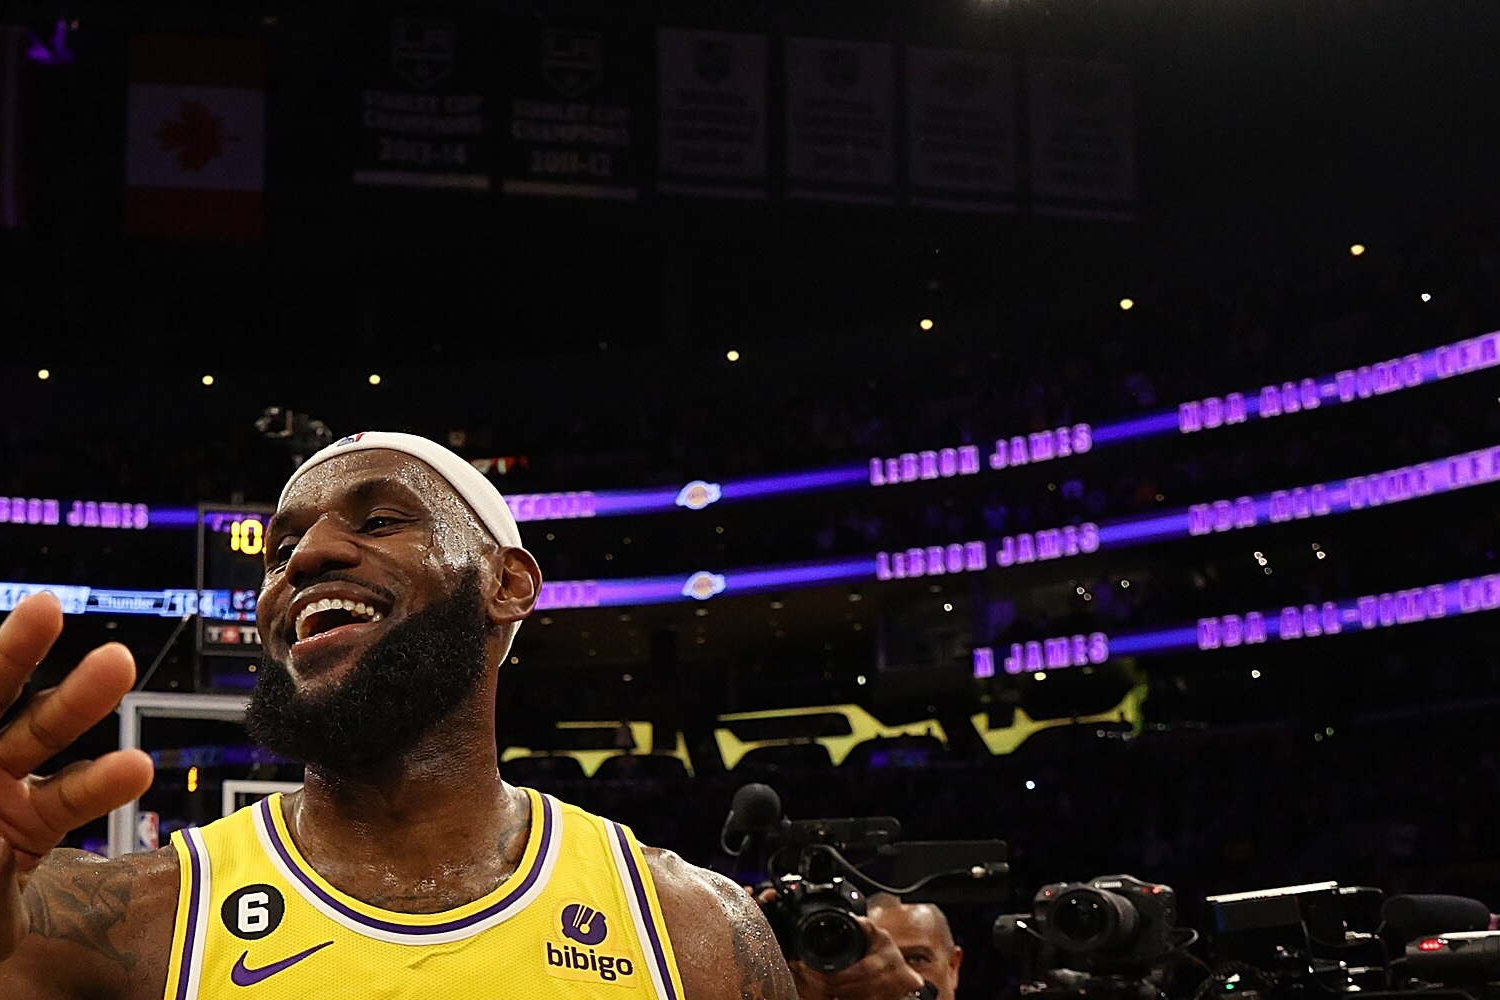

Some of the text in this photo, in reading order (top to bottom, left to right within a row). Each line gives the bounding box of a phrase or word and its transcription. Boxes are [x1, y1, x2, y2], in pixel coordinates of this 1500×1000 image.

[66, 500, 149, 530] JAMES
[237, 891, 270, 932] 6
[546, 941, 634, 981] bibigo
